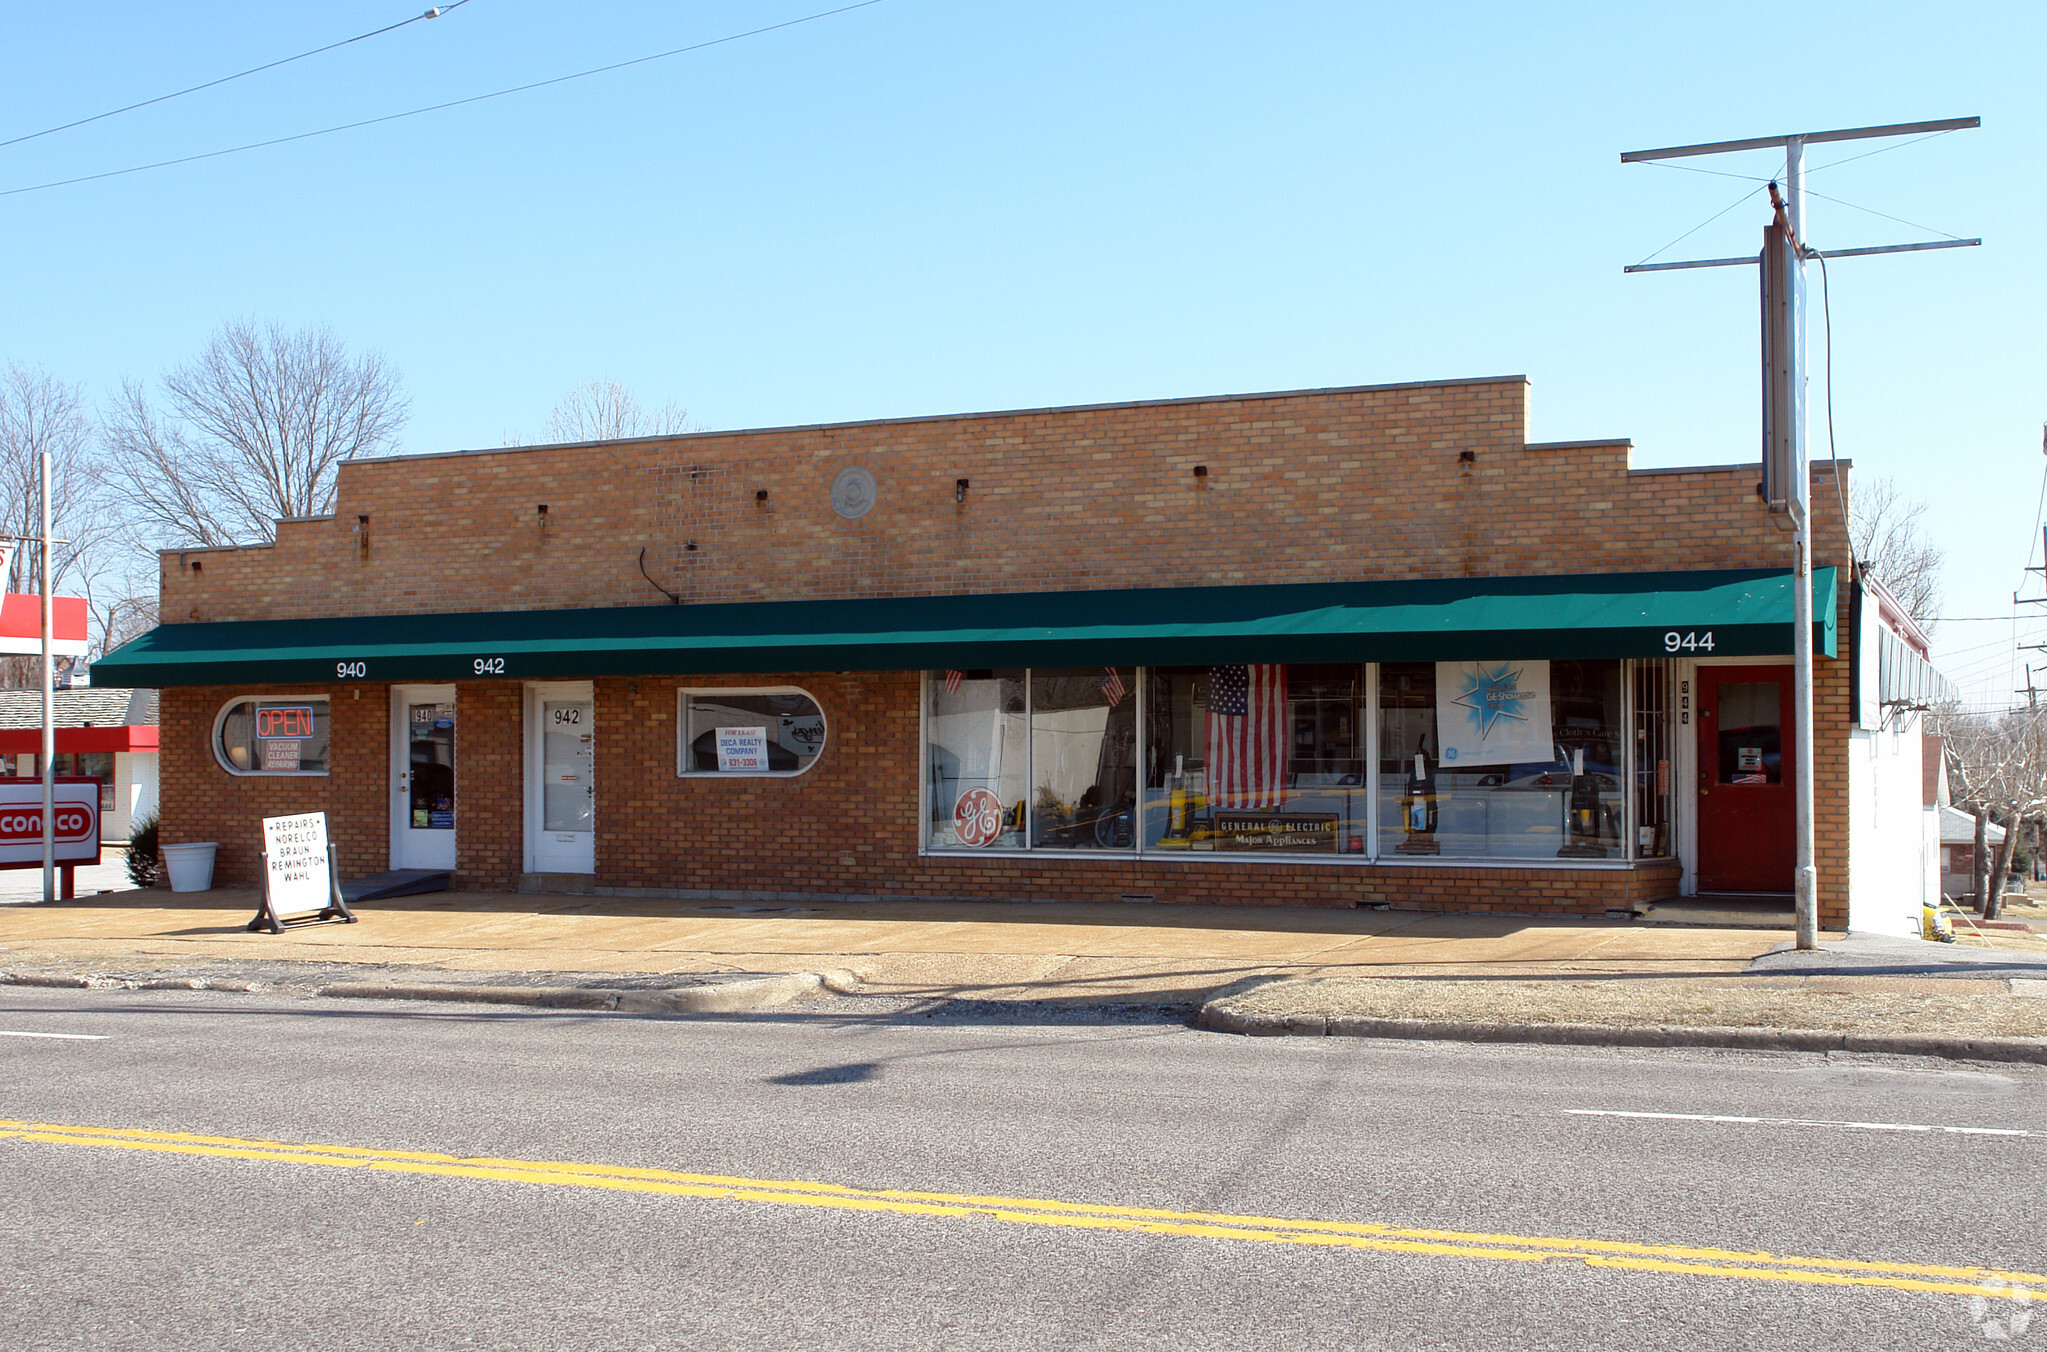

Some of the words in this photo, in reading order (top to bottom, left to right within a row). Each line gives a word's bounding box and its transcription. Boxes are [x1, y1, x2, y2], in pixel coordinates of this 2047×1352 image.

[1664, 631, 1716, 653] 944
[336, 661, 366, 678] 940
[473, 657, 505, 675] 942
[258, 710, 311, 736] OPEN
[416, 710, 432, 722] 940
[555, 709, 579, 725] 942
[269, 743, 298, 751] VACUUM
[720, 739, 737, 747] DECA
[740, 738, 762, 747] REALTY
[267, 751, 298, 760] CLEANER
[726, 747, 758, 755] COMPANY
[0, 814, 83, 833] conco
[275, 818, 315, 832] REPAIRS
[1221, 822, 1265, 831] GENERAL
[1285, 822, 1331, 832] ELECTRIC
[275, 830, 318, 844] NORELCO
[280, 845, 310, 858] BRAUN
[271, 856, 325, 871] REMINGTON
[284, 870, 310, 882] WAHL
